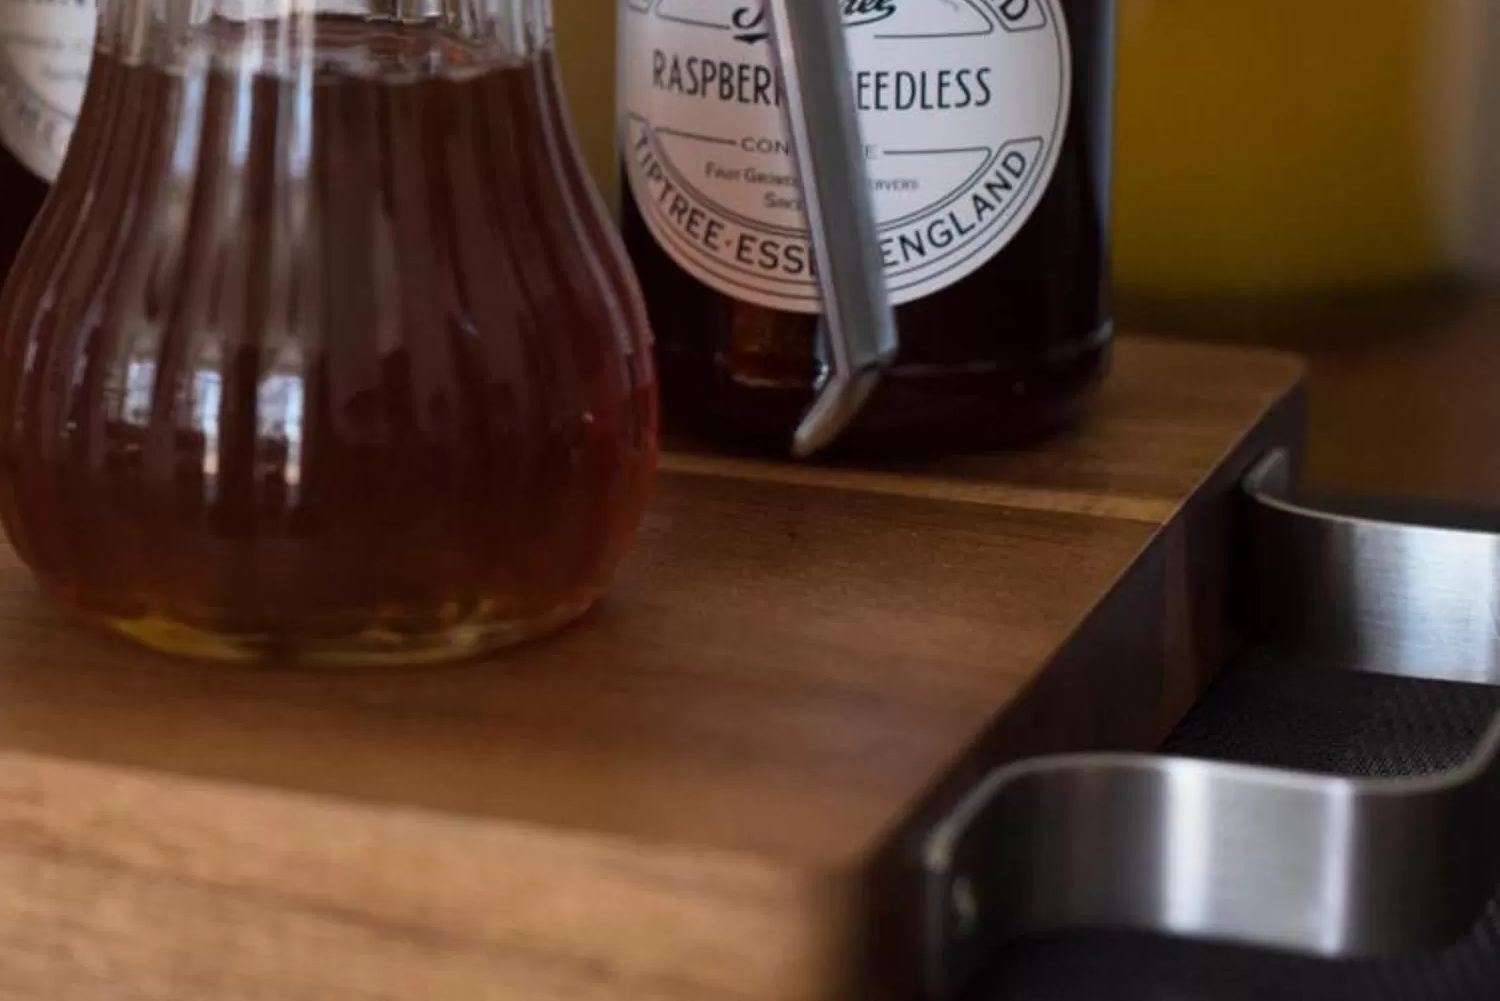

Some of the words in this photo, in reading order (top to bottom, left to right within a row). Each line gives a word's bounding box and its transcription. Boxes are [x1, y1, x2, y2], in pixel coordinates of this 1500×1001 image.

[653, 49, 781, 108] RASPBER
[856, 67, 992, 111] EEDLESS
[634, 135, 723, 251] TIPTREE
[735, 234, 818, 280] ESS
[880, 150, 1027, 270] ENGLAND
